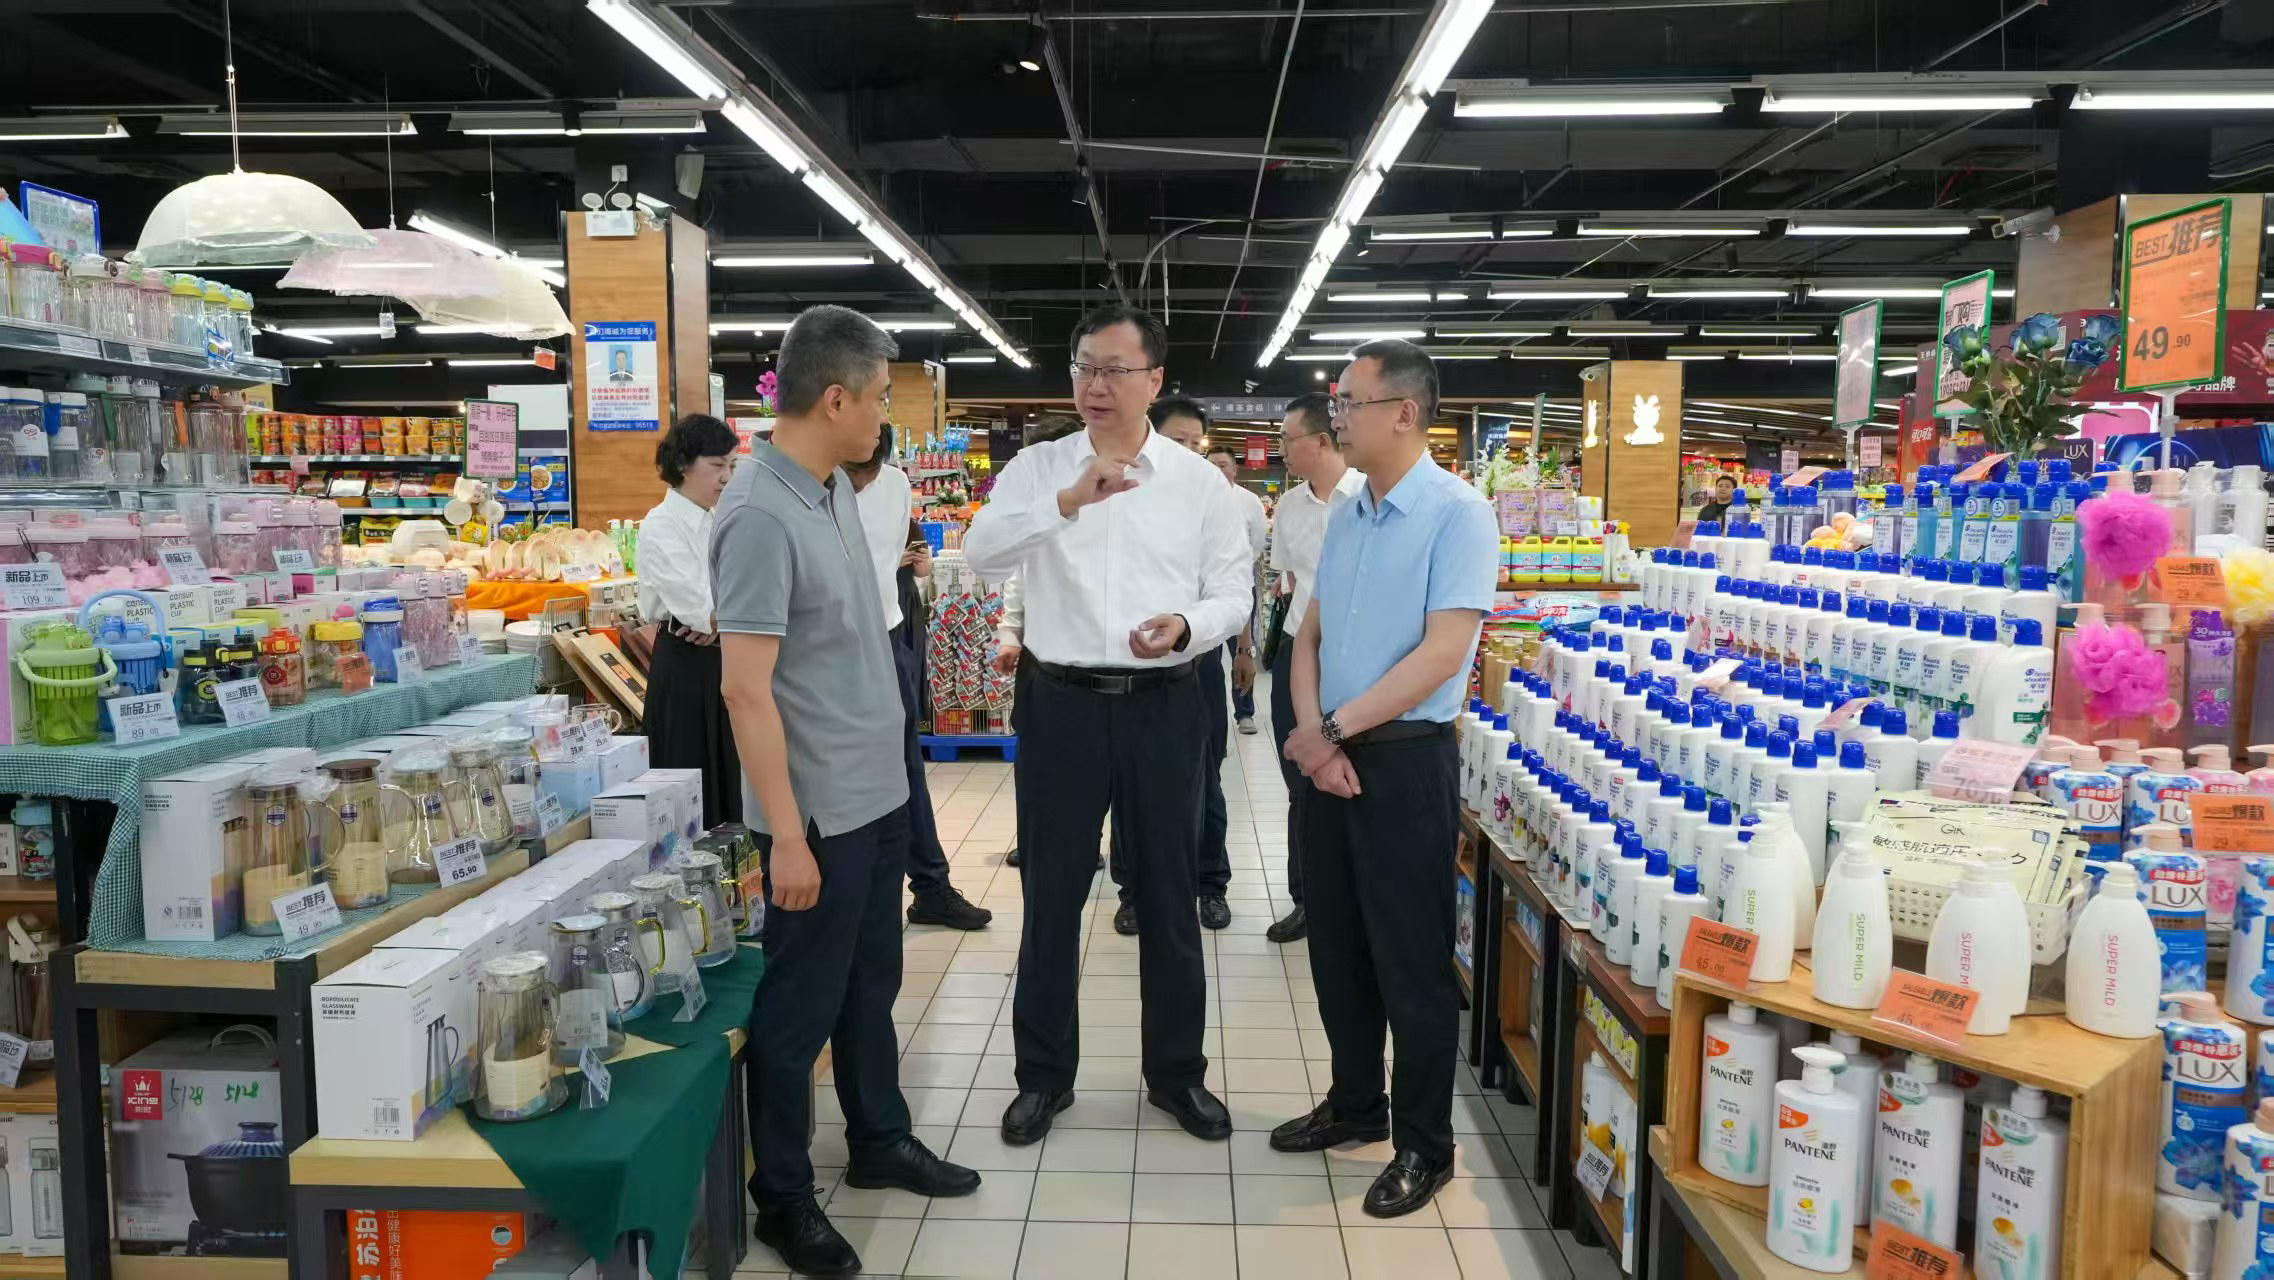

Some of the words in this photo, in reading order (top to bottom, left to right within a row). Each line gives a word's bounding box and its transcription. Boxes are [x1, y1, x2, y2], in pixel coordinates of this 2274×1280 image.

[2136, 235, 2168, 258] BEST
[2168, 213, 2222, 255] 推荐
[2064, 444, 2089, 460] LUX
[5, 570, 50, 583] 新品上市
[169, 601, 195, 609] PLASTIC
[213, 597, 236, 606] PLASTIC
[170, 610, 182, 618] CUP
[239, 685, 258, 697] 推荐
[120, 703, 161, 717] 新品上市
[2074, 803, 2120, 823] LUX
[2160, 804, 2191, 825] LU
[2233, 804, 2264, 820] 爆款
[439, 849, 455, 859] BEST
[455, 840, 476, 855] 推荐
[452, 865, 477, 880] 65.90
[286, 902, 302, 912] BEST
[302, 890, 326, 907] 推荐
[1747, 889, 1756, 926] SUPER
[2152, 886, 2204, 908] LUX
[1721, 933, 1751, 953] 爆款
[1854, 913, 1866, 952] SUPER
[1960, 932, 1972, 972] SUPER
[2107, 935, 2119, 976] SUPER
[1853, 954, 1864, 981] MILD
[1930, 988, 1969, 1010] 爆款
[2105, 977, 2117, 1006] MILD
[1710, 1065, 1753, 1086] PANTENE
[2176, 1057, 2240, 1083] LUX
[1882, 1122, 1929, 1148] PANTENE
[1784, 1138, 1836, 1161] PANTENE
[1985, 1156, 2035, 1188] PANTENE
[1910, 1247, 1949, 1275] 推荐
